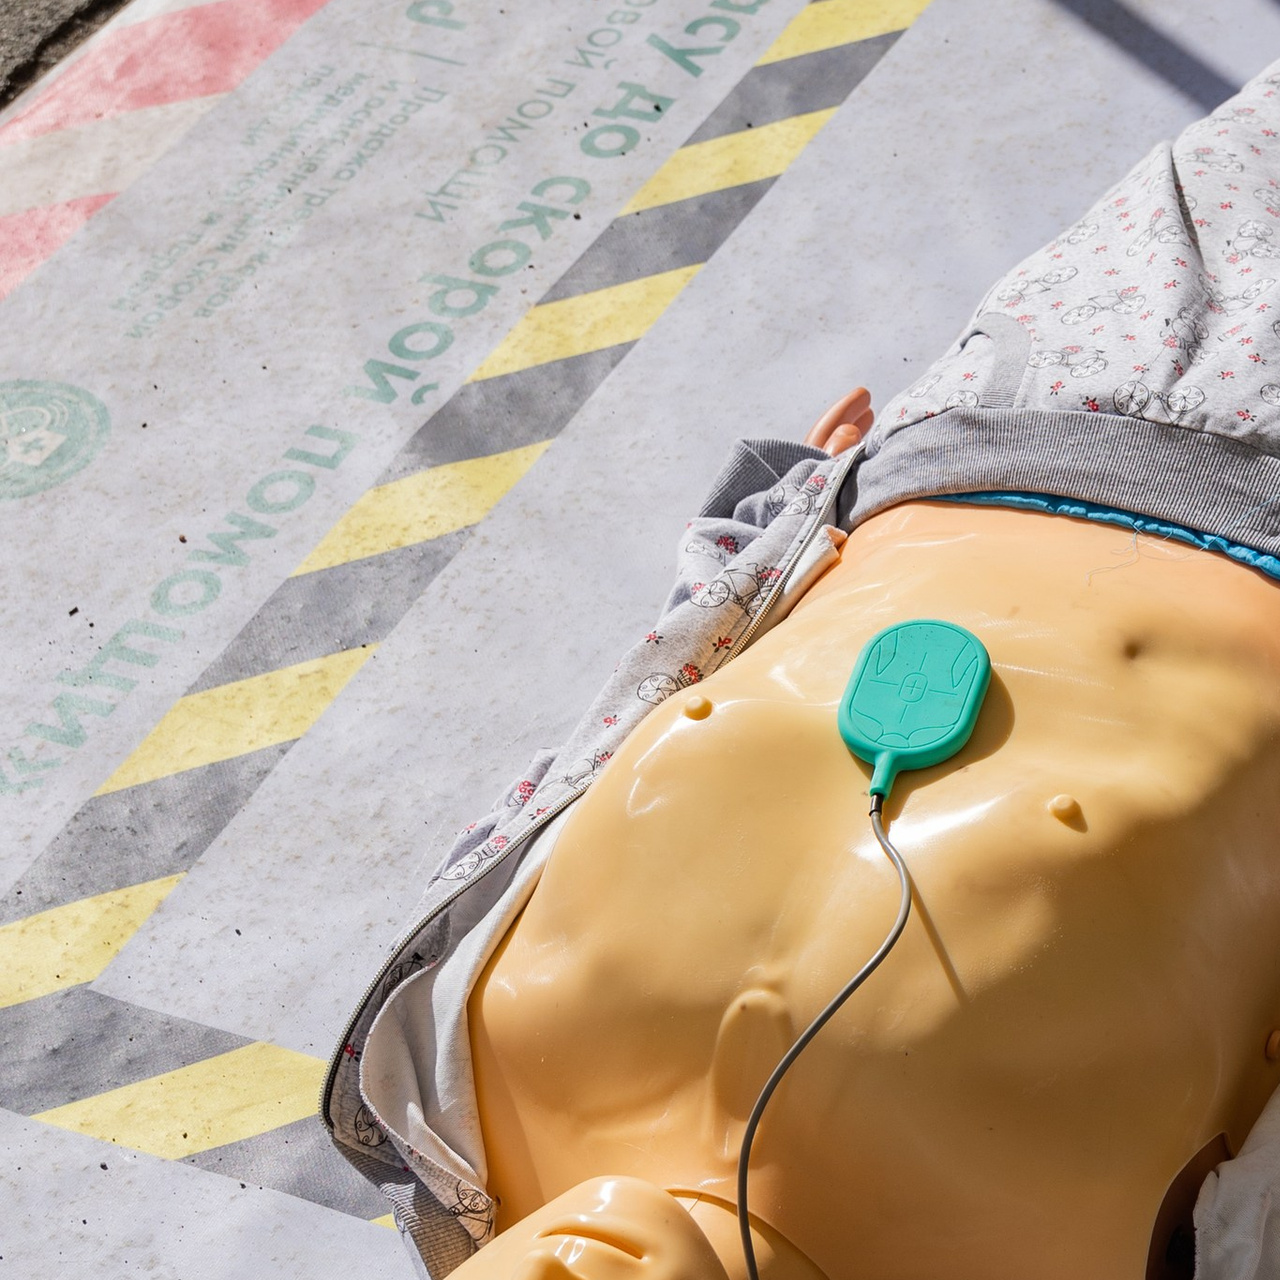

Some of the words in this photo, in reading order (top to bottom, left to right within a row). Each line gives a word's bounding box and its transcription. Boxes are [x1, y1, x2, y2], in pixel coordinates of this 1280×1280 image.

[334, 86, 449, 183] Продажа
[414, 78, 577, 224] помощи
[579, 81, 677, 159] до
[341, 175, 592, 406] скорой
[0, 423, 361, 795] помощи»
